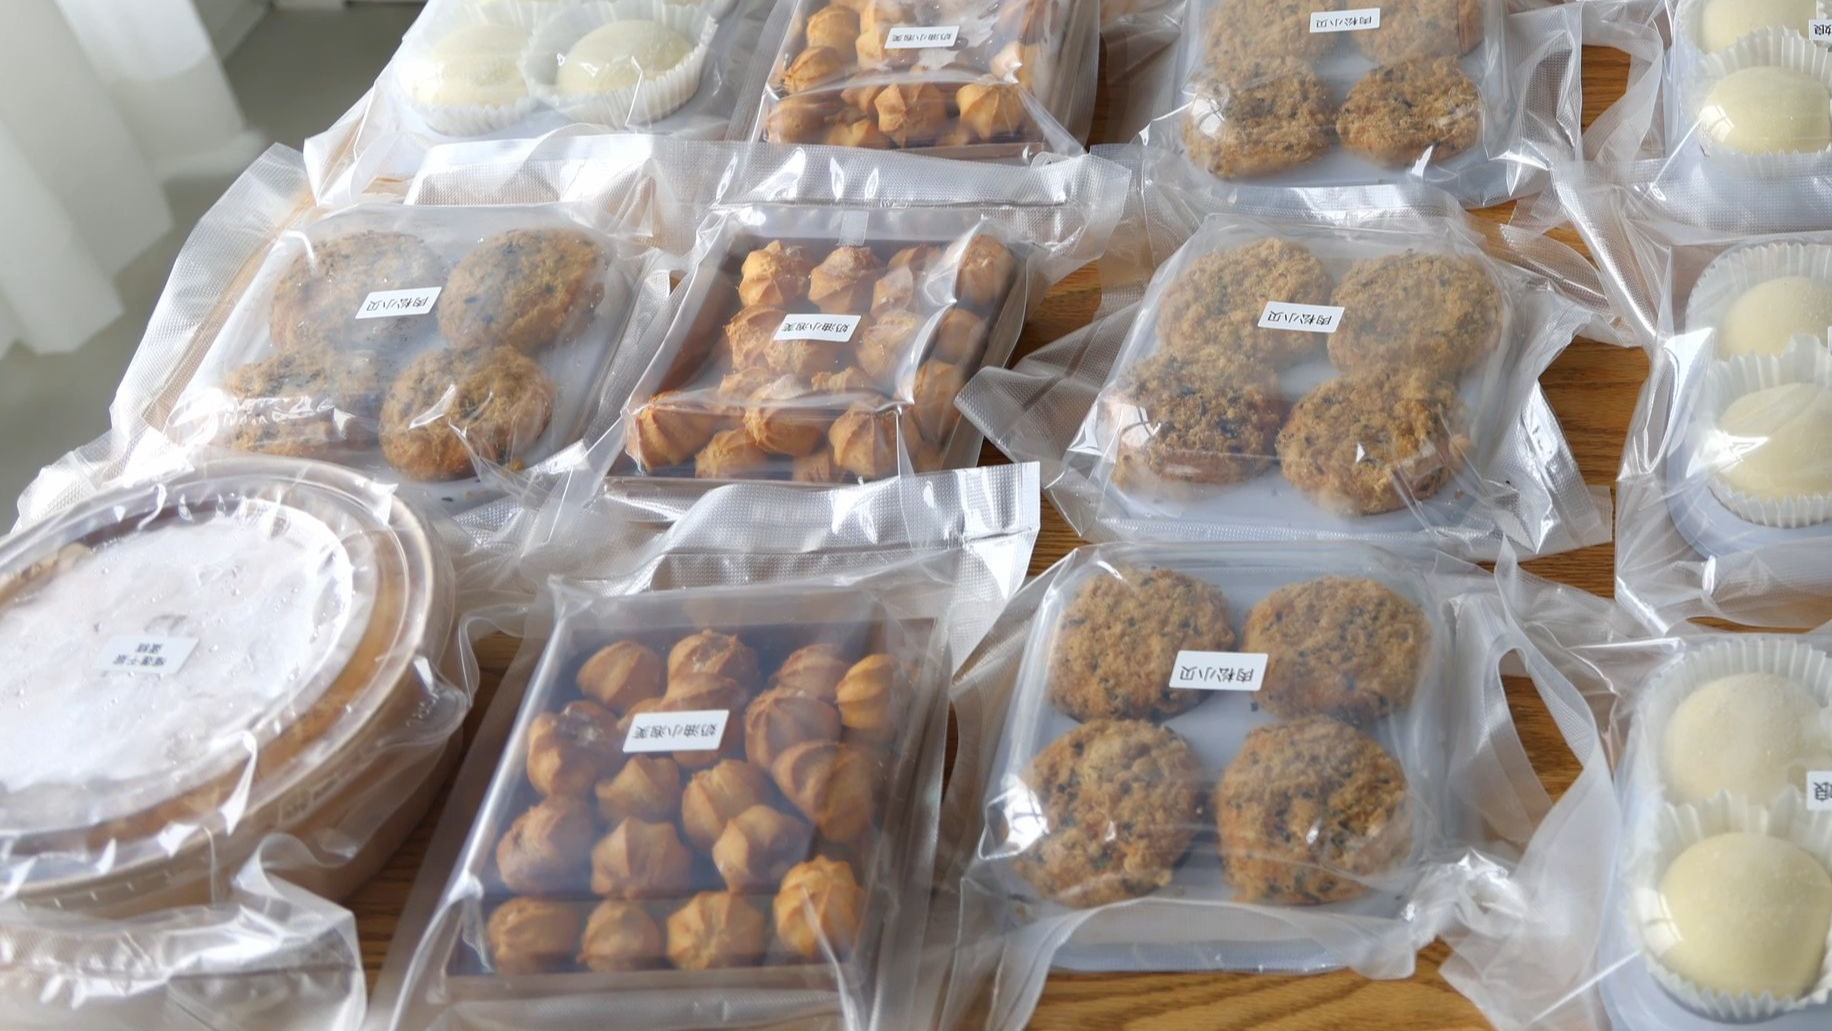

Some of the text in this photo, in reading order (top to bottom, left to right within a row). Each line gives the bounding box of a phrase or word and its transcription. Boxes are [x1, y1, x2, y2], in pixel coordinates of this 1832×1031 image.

[1315, 16, 1372, 28] 肉松小贝
[366, 296, 429, 311] 肉松小贝
[1267, 310, 1332, 325] 肉松小贝
[781, 322, 849, 332] 奶油小泡芙
[1179, 665, 1254, 683] 肉松小贝
[633, 722, 717, 740] 奶油小泡芙
